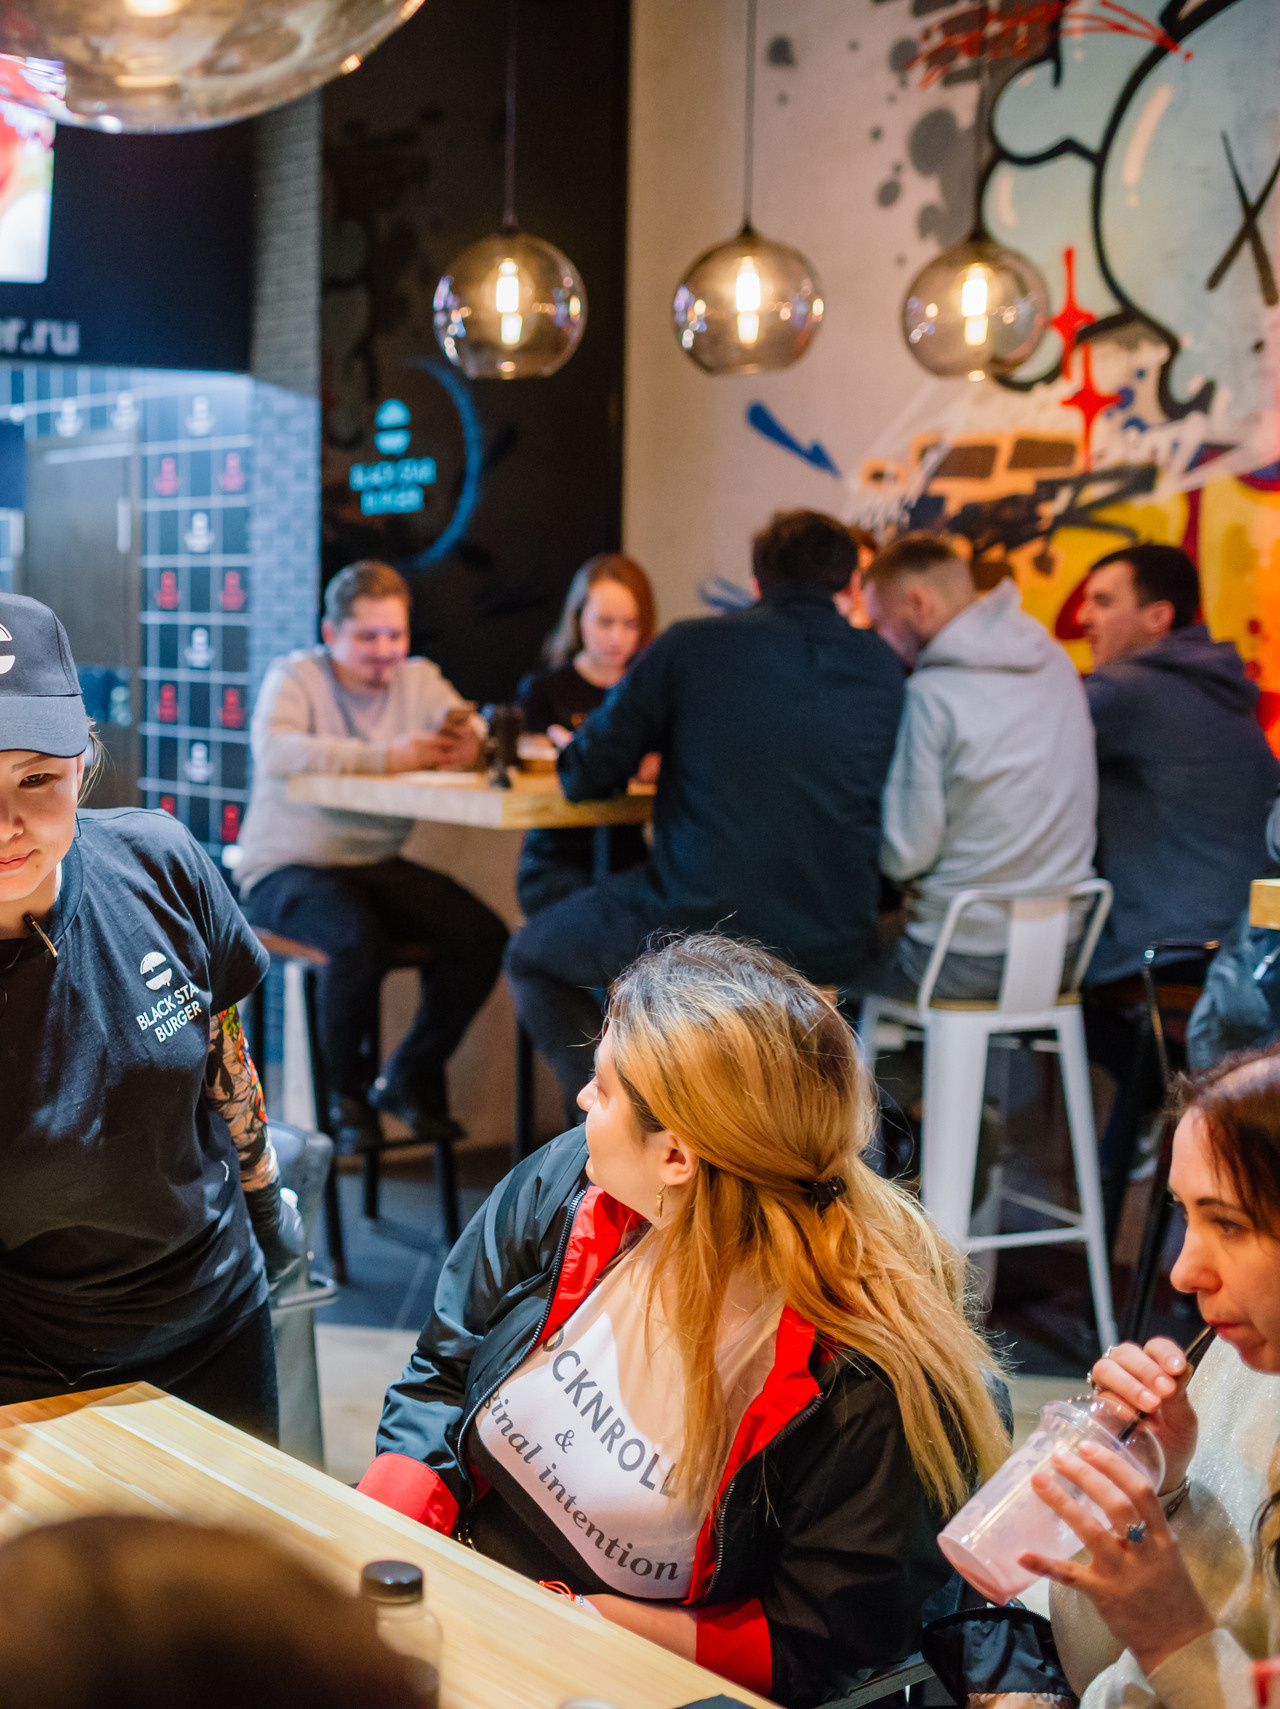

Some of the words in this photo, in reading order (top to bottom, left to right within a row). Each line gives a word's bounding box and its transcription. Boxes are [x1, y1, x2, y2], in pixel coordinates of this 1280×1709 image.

[136, 995, 177, 1031] BLACK
[154, 1000, 202, 1044] BURGER
[554, 1429, 576, 1454] &
[538, 1462, 679, 1581] intention
